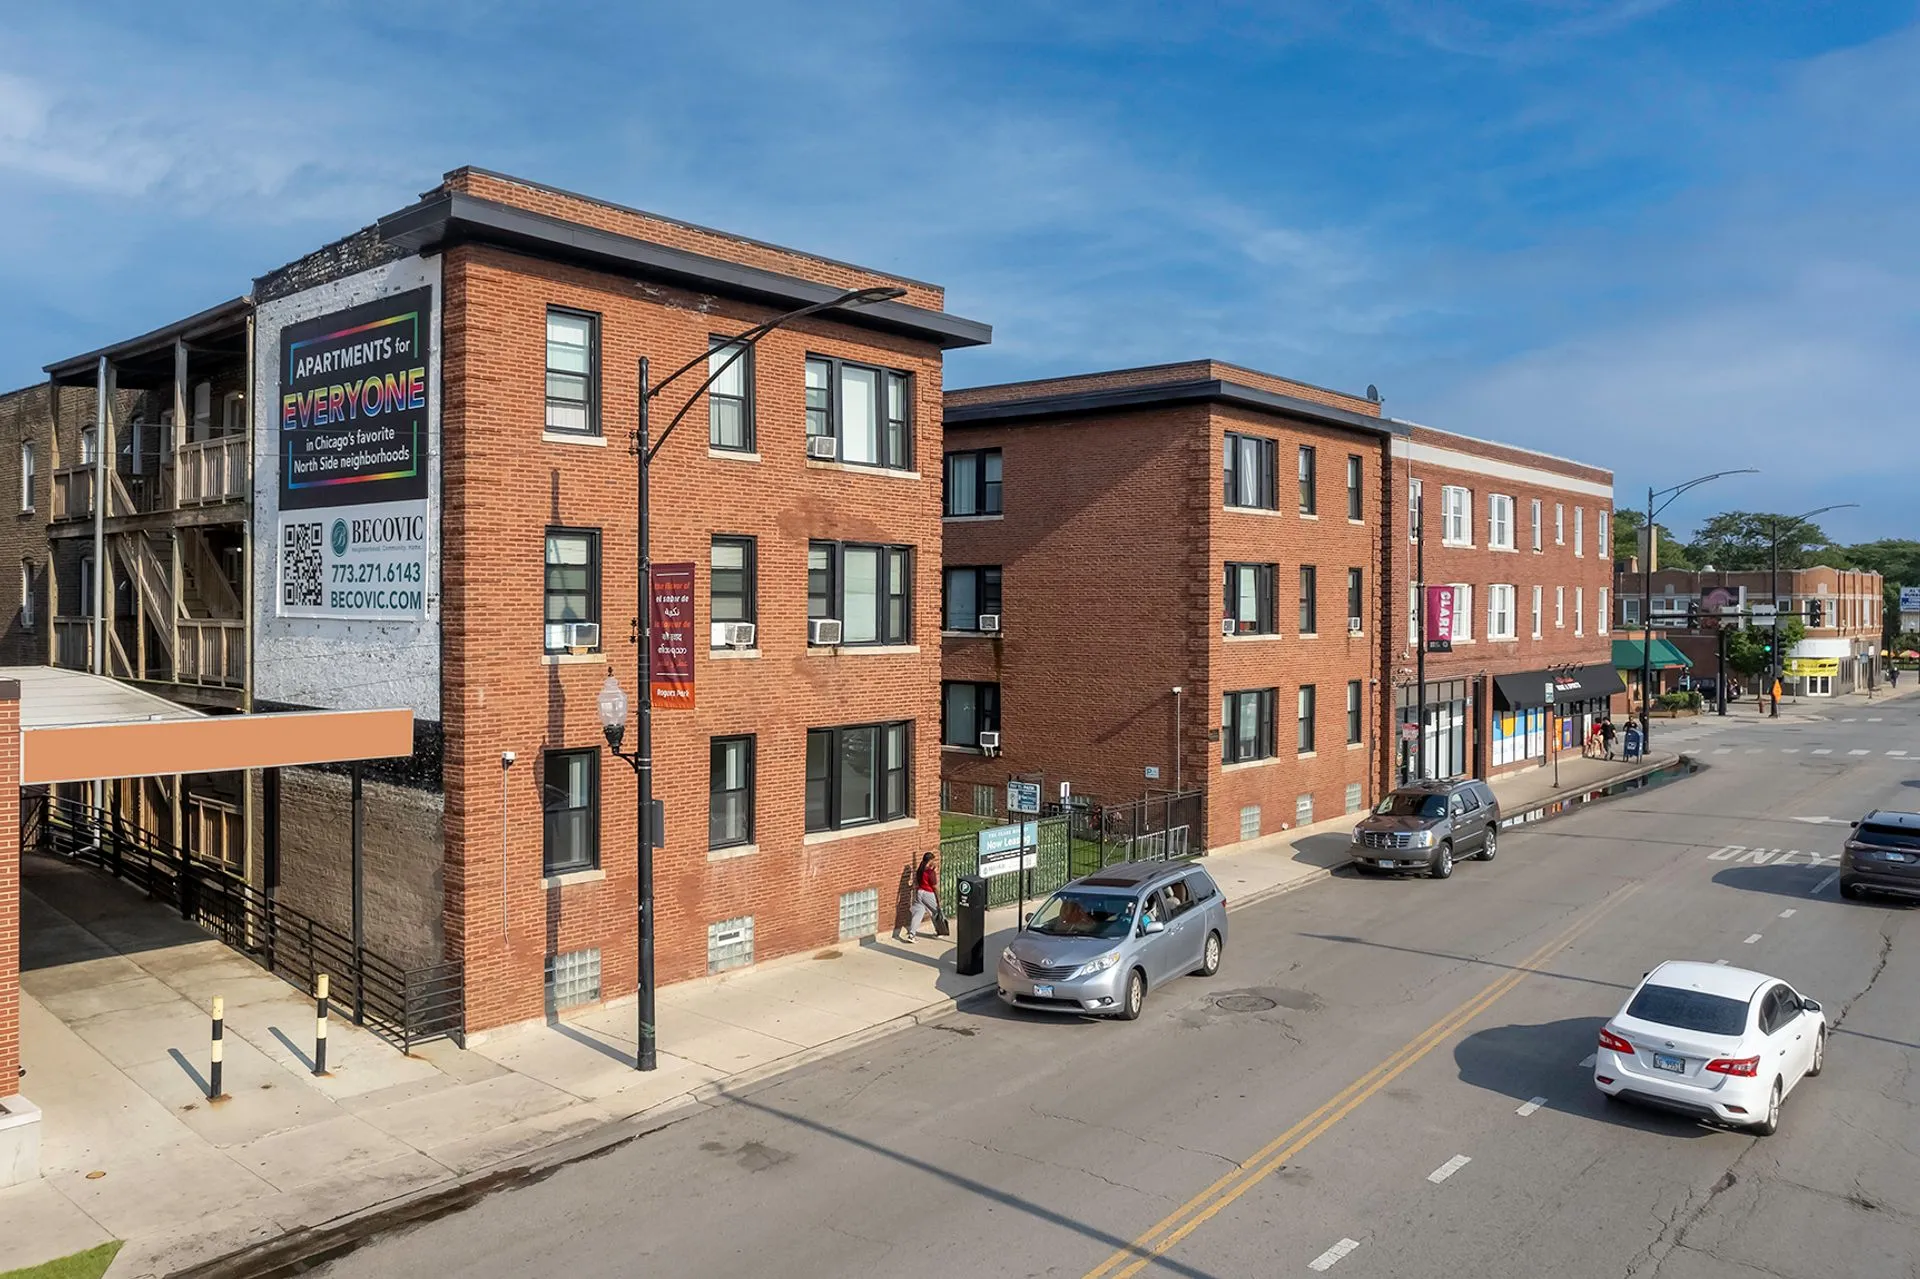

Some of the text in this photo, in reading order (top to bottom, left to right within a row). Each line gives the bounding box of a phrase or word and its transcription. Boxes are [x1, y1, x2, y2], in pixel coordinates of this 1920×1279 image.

[296, 337, 411, 379] APARTMENTS for
[283, 366, 426, 431] EVERYONE
[306, 426, 395, 452] in Chicago's favorite
[294, 445, 410, 474] North Side neighborhoods
[352, 515, 423, 544] BECOVIC
[332, 562, 421, 583] 773.271.6143
[331, 590, 422, 610] BECOVIC.COM
[1438, 591, 1452, 637] CLARK
[986, 835, 1031, 851] Now Leasng
